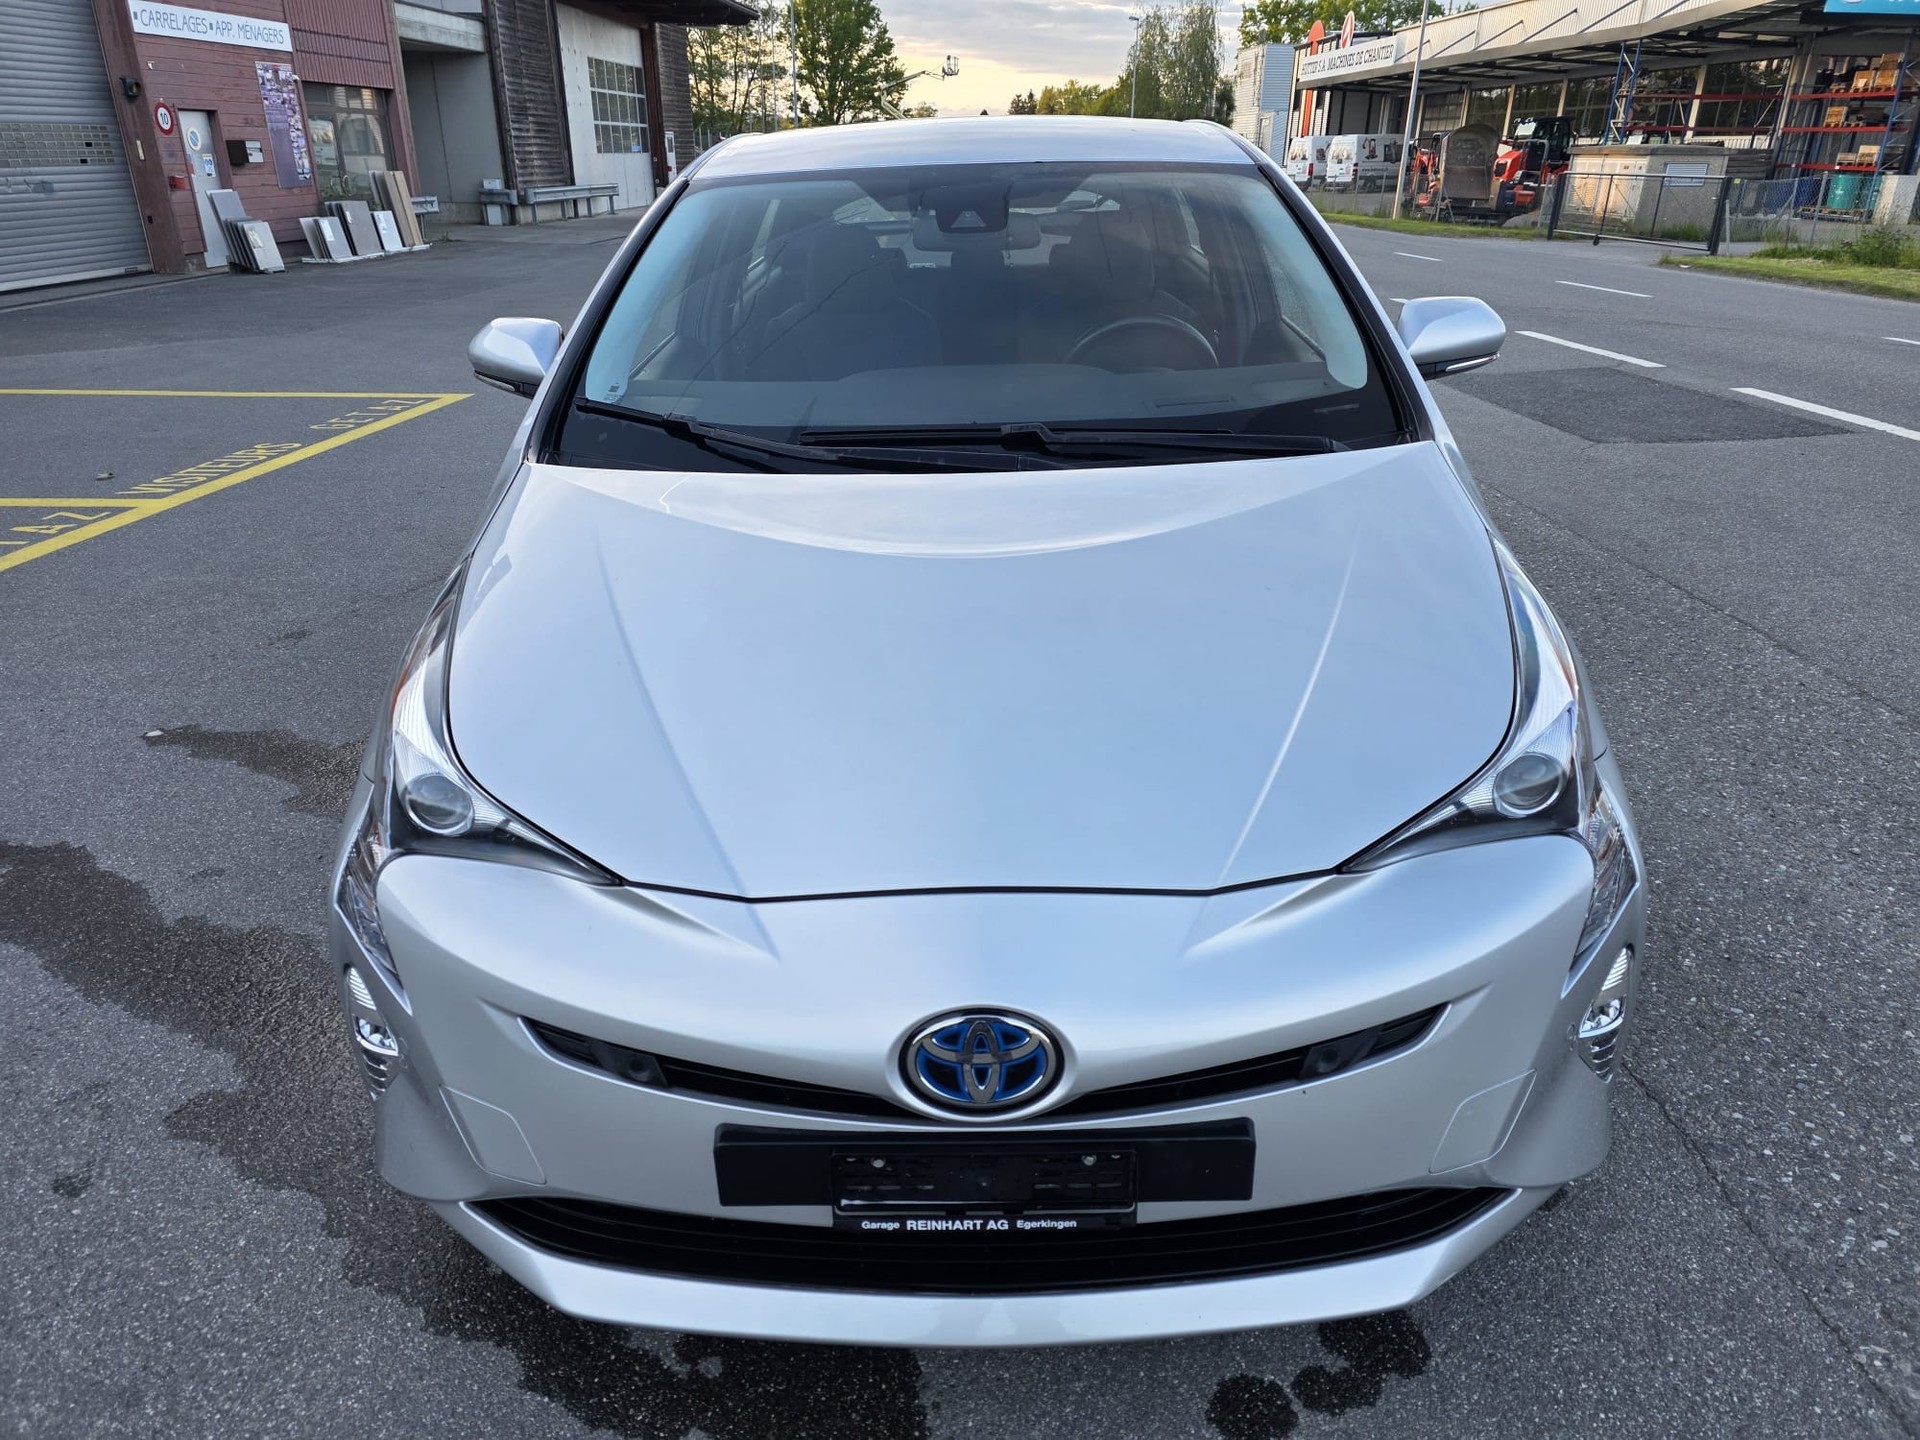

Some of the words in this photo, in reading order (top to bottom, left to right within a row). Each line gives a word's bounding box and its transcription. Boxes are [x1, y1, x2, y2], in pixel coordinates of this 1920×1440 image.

[140, 9, 208, 34] CARRELAGES
[215, 20, 235, 38] APP.
[237, 21, 285, 44] MÉNAGERS
[1355, 51, 1364, 65] DE
[1363, 44, 1395, 64] CHANTIER
[160, 112, 169, 125] 10
[310, 399, 425, 430] GETAZ
[114, 442, 302, 495] VISITEURS
[861, 1220, 900, 1231] Garage
[906, 1219, 983, 1231] REINHART
[986, 1219, 1009, 1231] AG
[1016, 1219, 1077, 1230] Egerkingen
